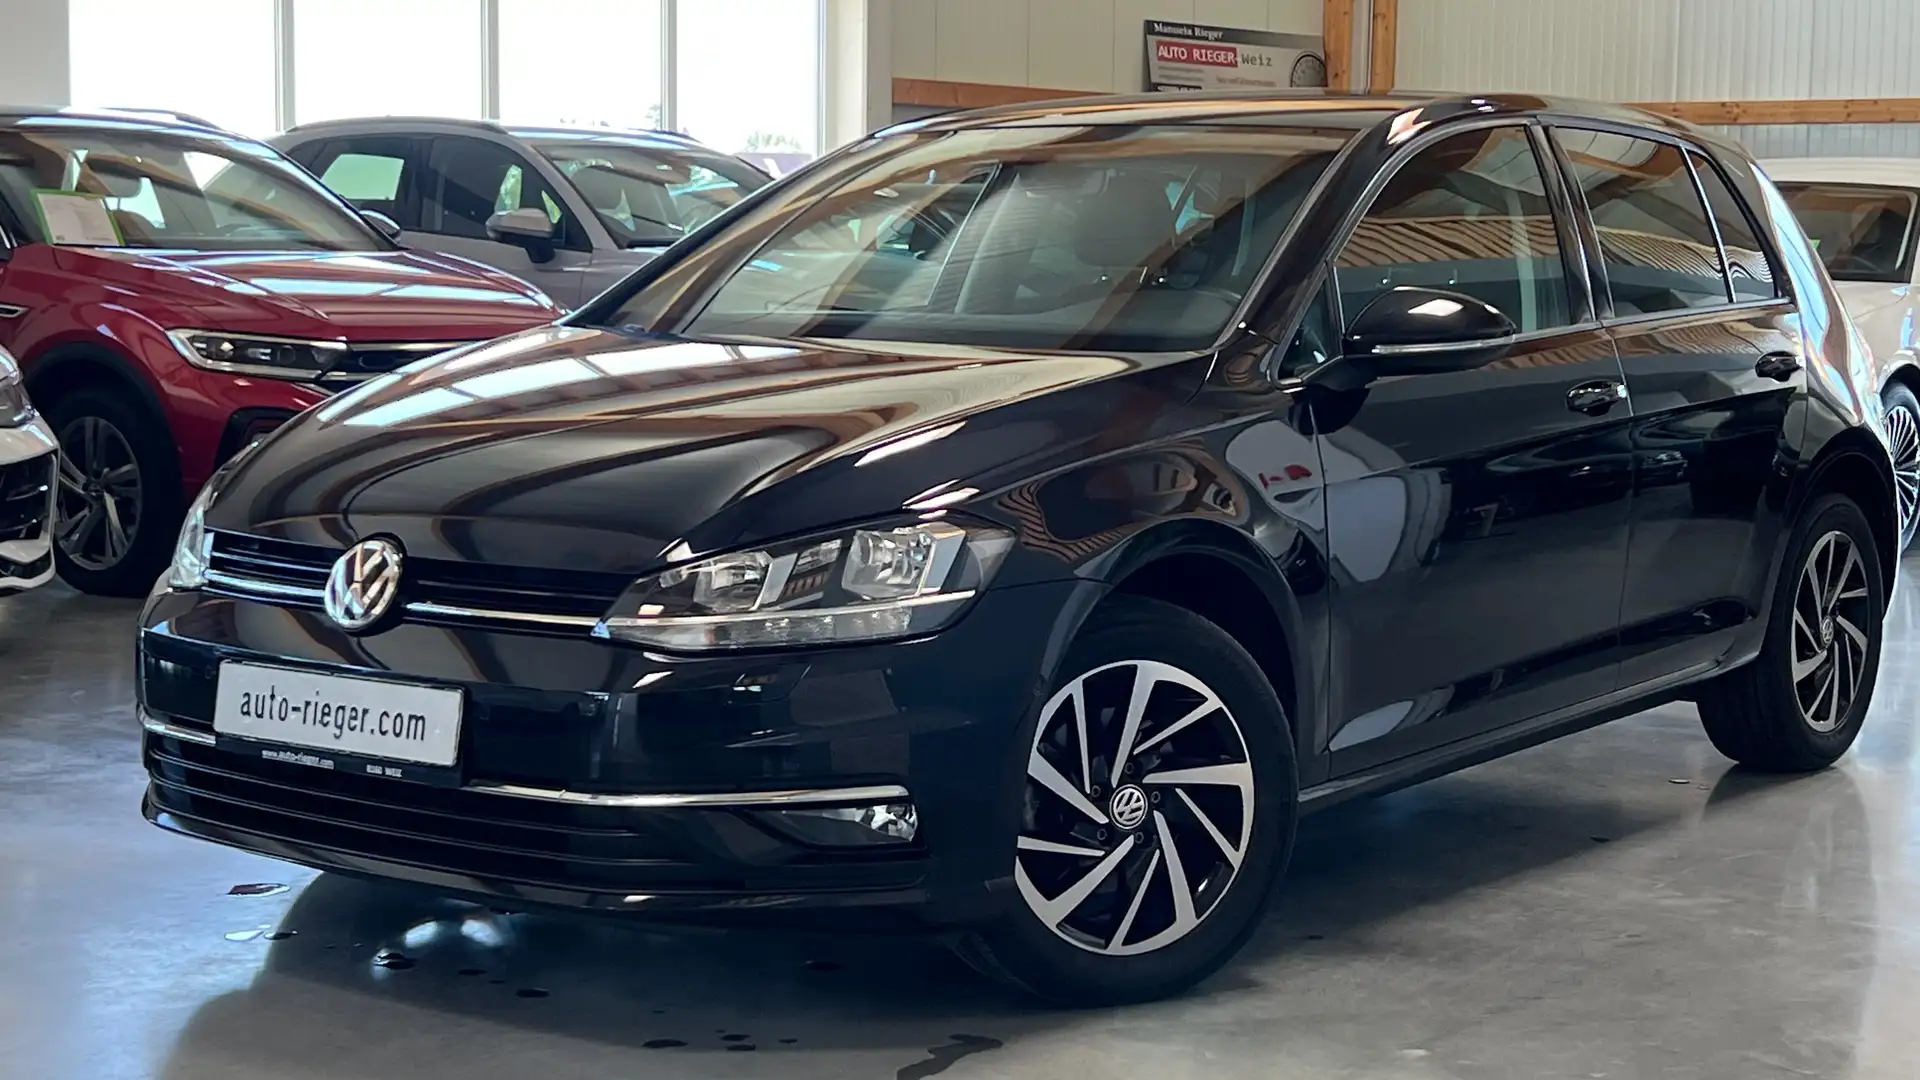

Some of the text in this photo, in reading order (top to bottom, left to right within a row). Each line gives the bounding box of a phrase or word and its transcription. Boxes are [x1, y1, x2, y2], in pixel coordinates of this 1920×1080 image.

[1194, 27, 1224, 41] Rieger
[1157, 45, 1188, 60] AUTO
[1193, 48, 1236, 64] RIEGER
[240, 685, 426, 742] auto-rieger.com
